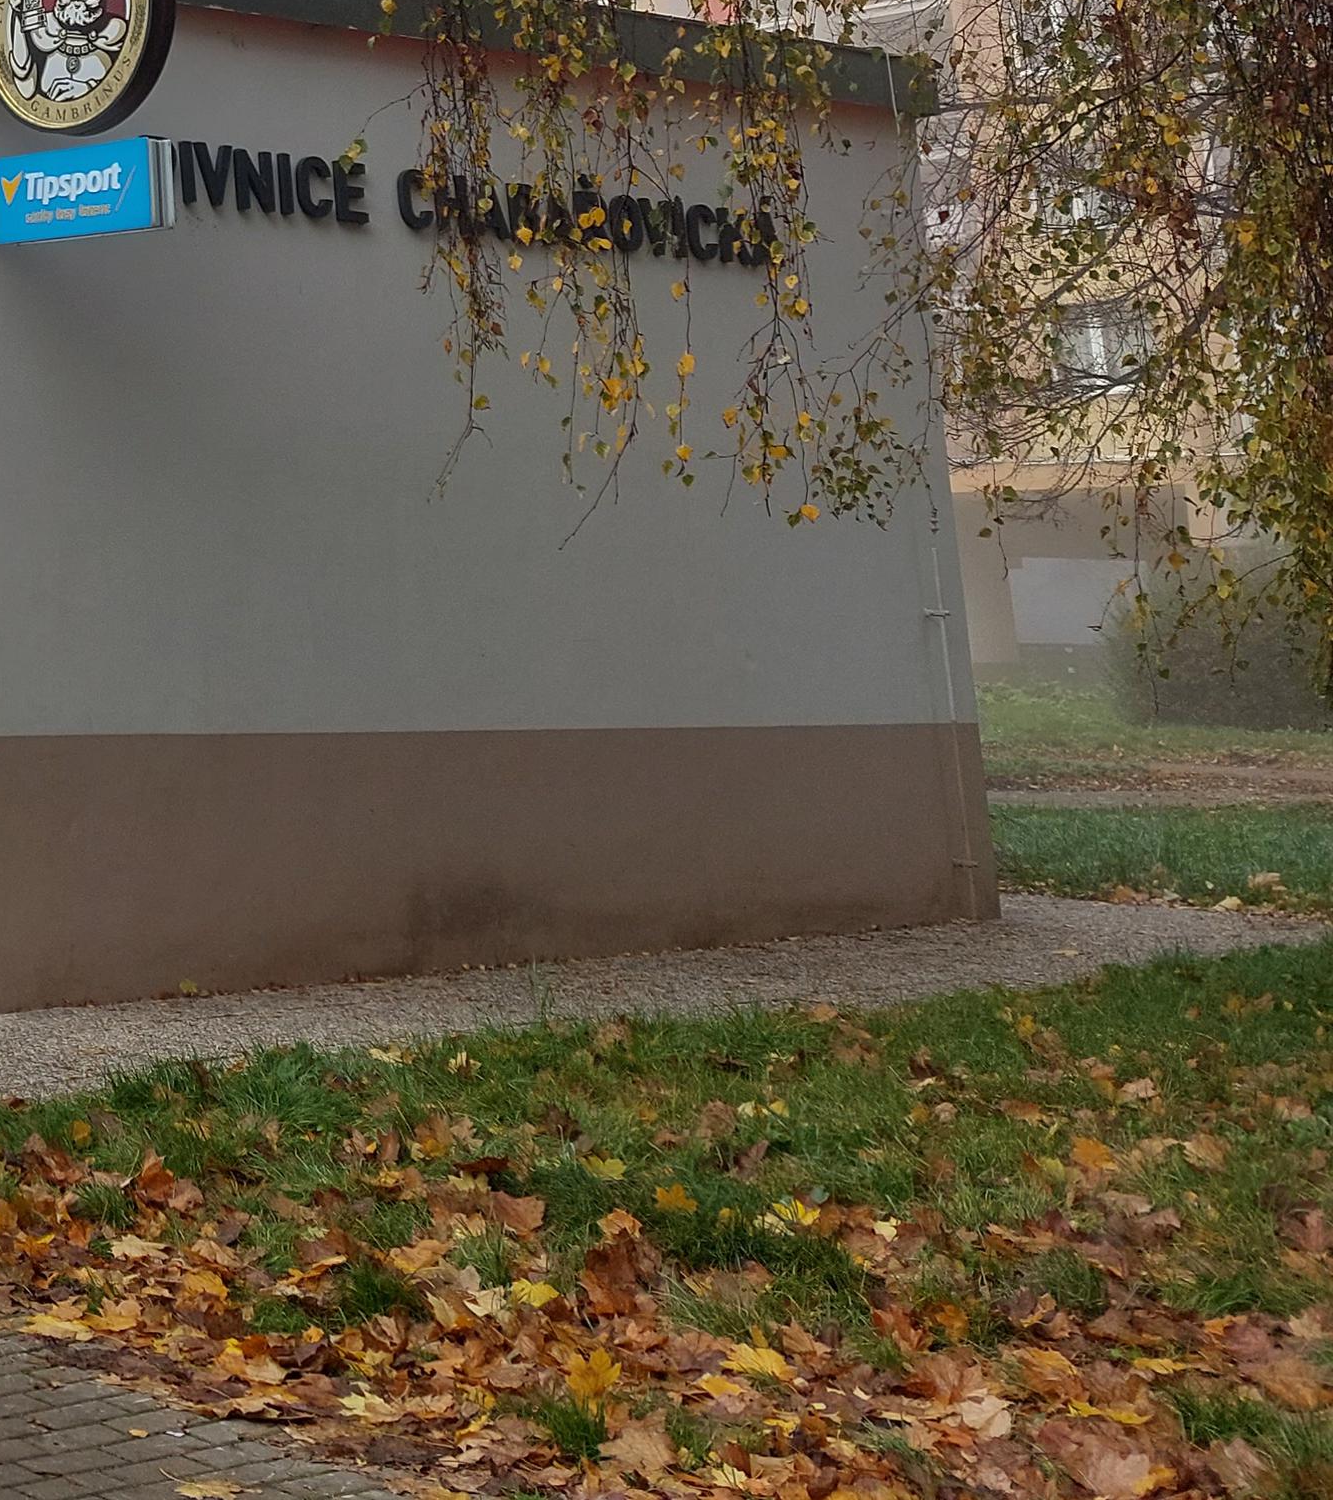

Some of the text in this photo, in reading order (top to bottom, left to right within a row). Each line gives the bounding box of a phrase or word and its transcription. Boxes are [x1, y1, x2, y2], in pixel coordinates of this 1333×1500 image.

[30, 55, 132, 122] GAMBRINUS
[24, 162, 123, 205] Tipsport
[170, 140, 370, 225] IVNICE
